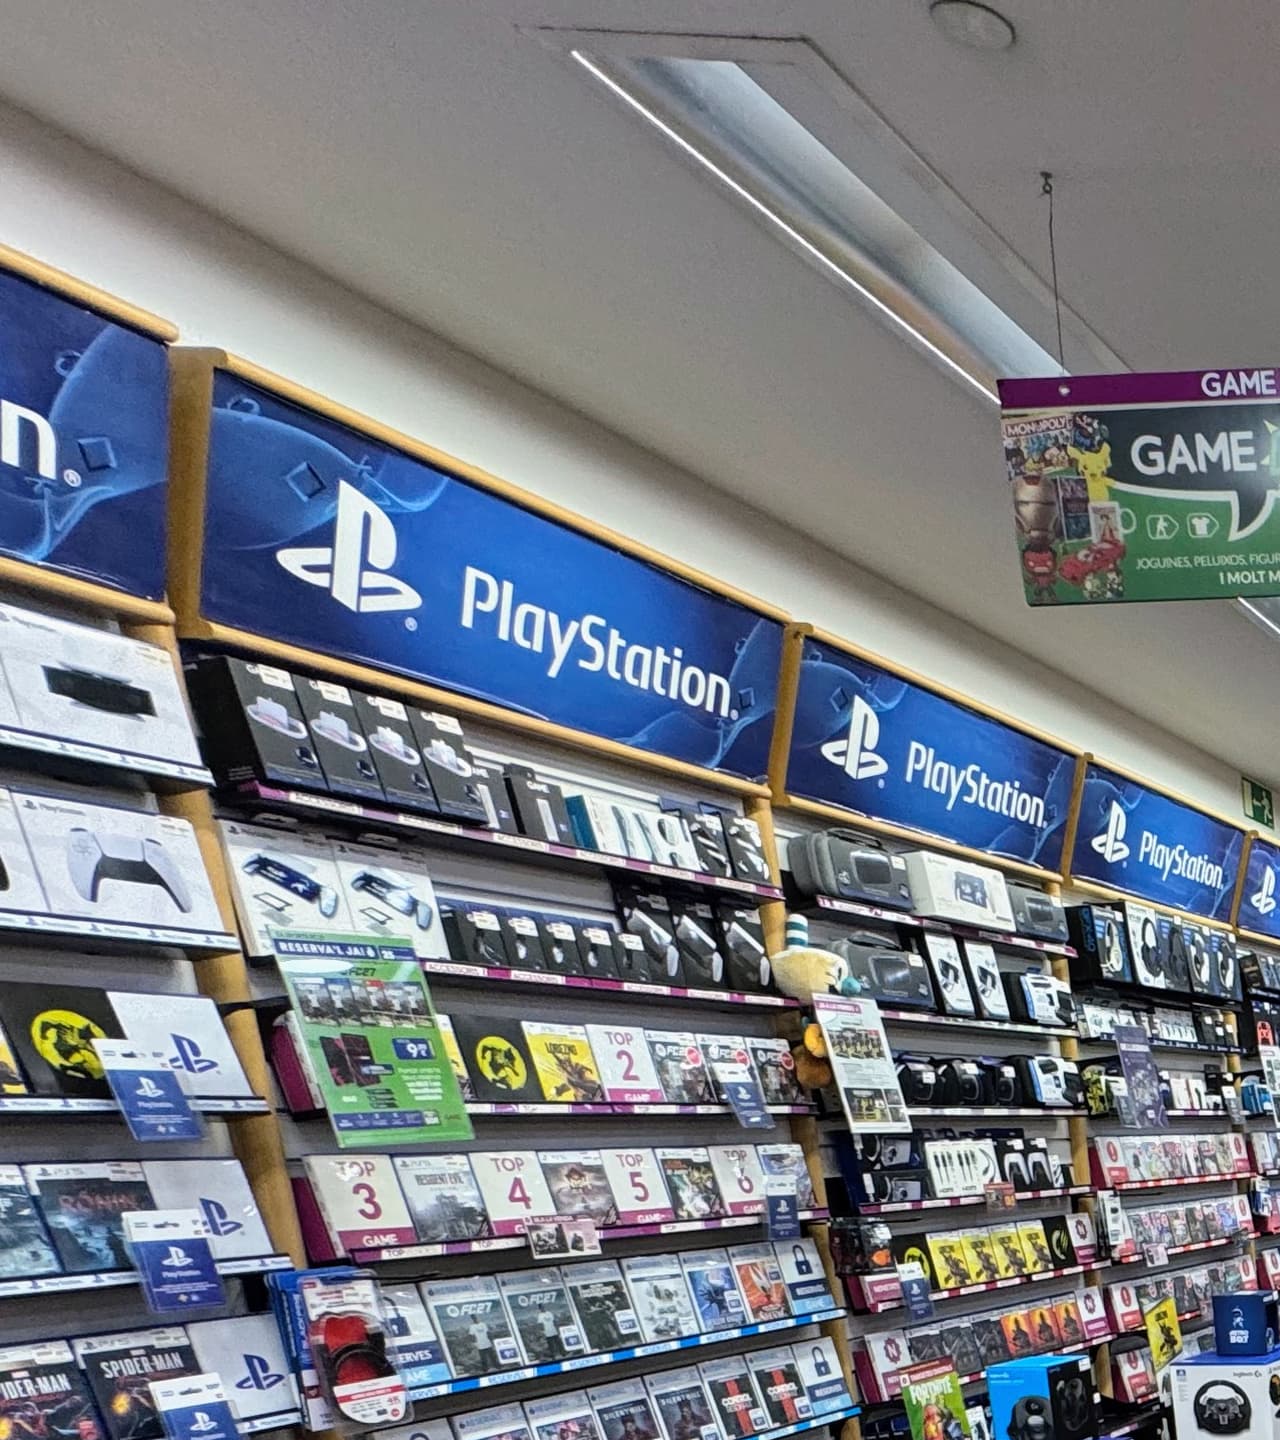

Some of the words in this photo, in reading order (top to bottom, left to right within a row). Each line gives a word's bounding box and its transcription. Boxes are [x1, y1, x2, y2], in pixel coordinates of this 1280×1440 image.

[1201, 370, 1277, 397] GAME
[1005, 416, 1069, 435] MONOPOLY
[1131, 431, 1257, 475] GAME
[1219, 573, 1224, 585] I
[1227, 571, 1265, 585] MOLT
[461, 566, 731, 719] PlayStation
[906, 740, 1046, 828] PlayStation
[1139, 831, 1222, 890] PlayStation
[603, 1031, 634, 1045] TOP
[616, 1050, 640, 1081] 2
[490, 1157, 525, 1172] TOP
[616, 1154, 644, 1168] TOP
[508, 1177, 532, 1210] 4
[630, 1172, 650, 1202] 5
[352, 1182, 382, 1220] 3
[362, 1234, 400, 1246] GAME
[460, 1302, 493, 1316] FC27
[529, 1292, 558, 1306] FC27
[100, 1352, 184, 1379] SPIDER-MAN
[399, 1350, 433, 1364] ERVES
[0, 1373, 71, 1400] IDER-MAN
[406, 1369, 431, 1383] AME
